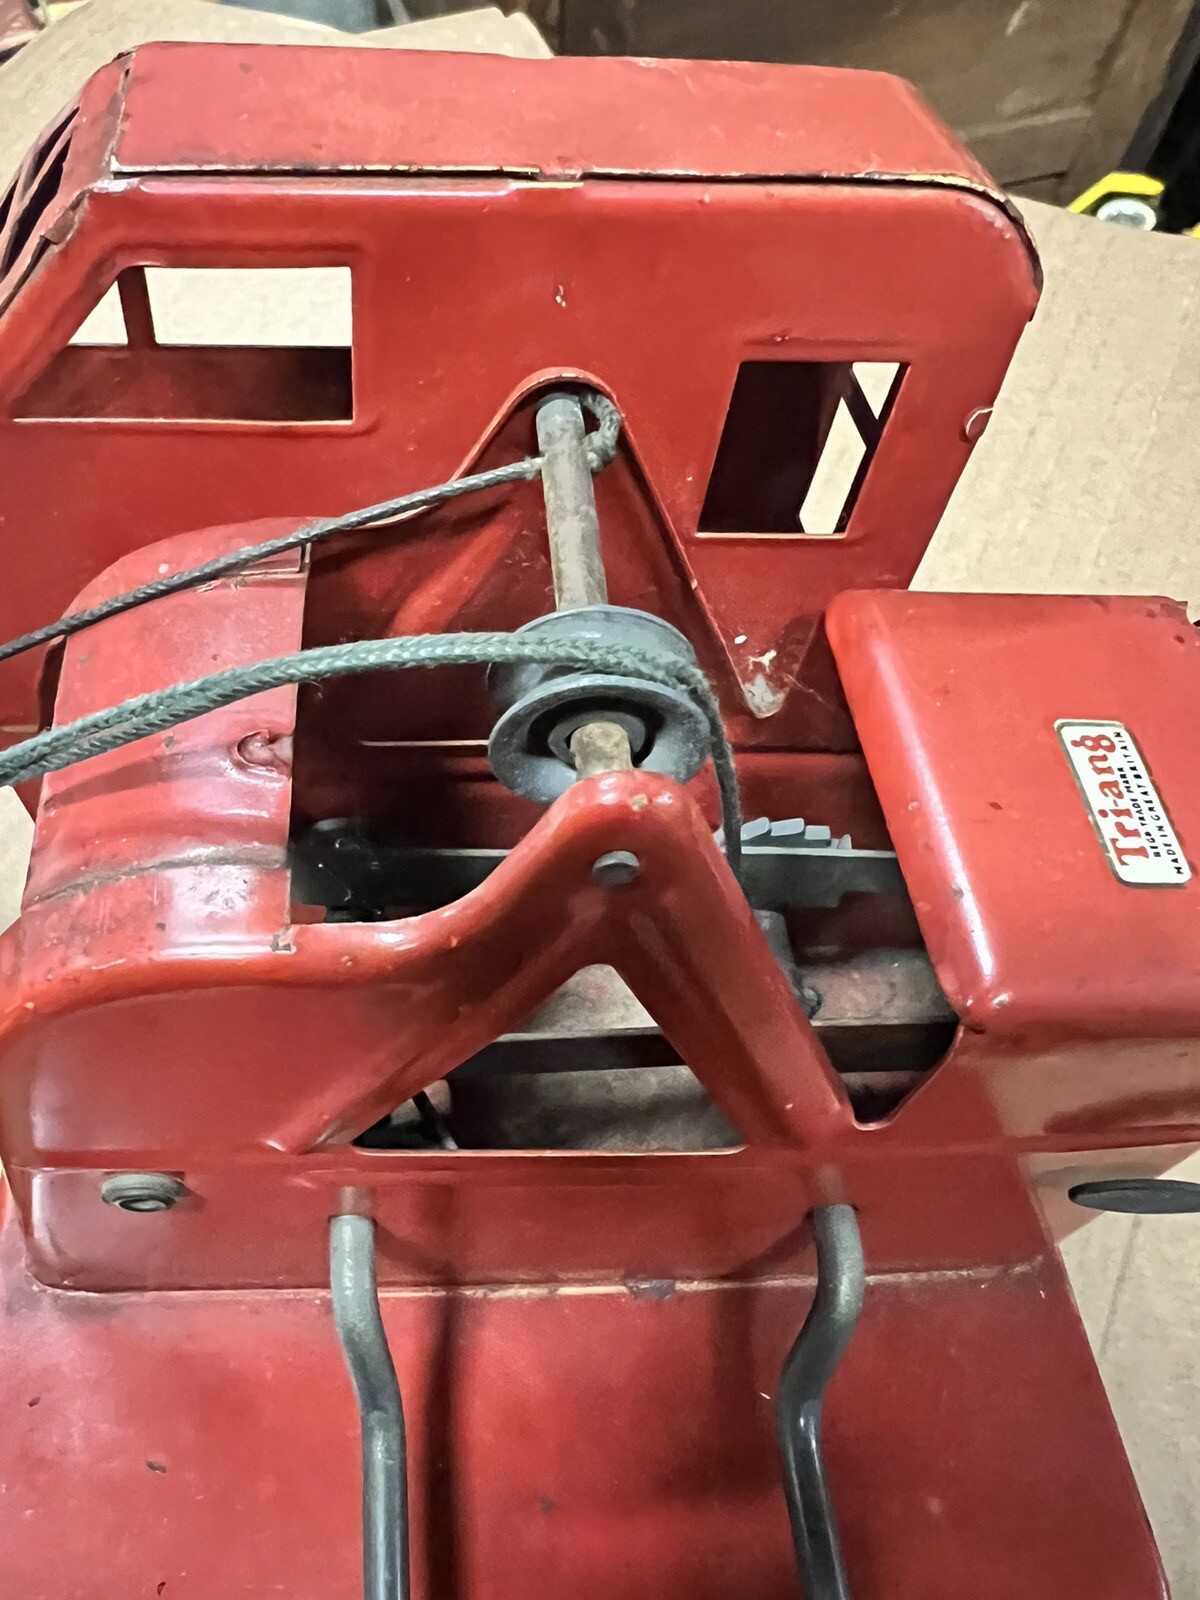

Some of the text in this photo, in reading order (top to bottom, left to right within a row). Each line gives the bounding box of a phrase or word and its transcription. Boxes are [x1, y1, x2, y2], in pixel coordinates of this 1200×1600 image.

[1070, 734, 1149, 866] Tri-ang
[1113, 732, 1184, 874] MADE IN GREAT BRITAIN
[1117, 767, 1134, 793] MARK
[1130, 798, 1147, 826] TRADE
